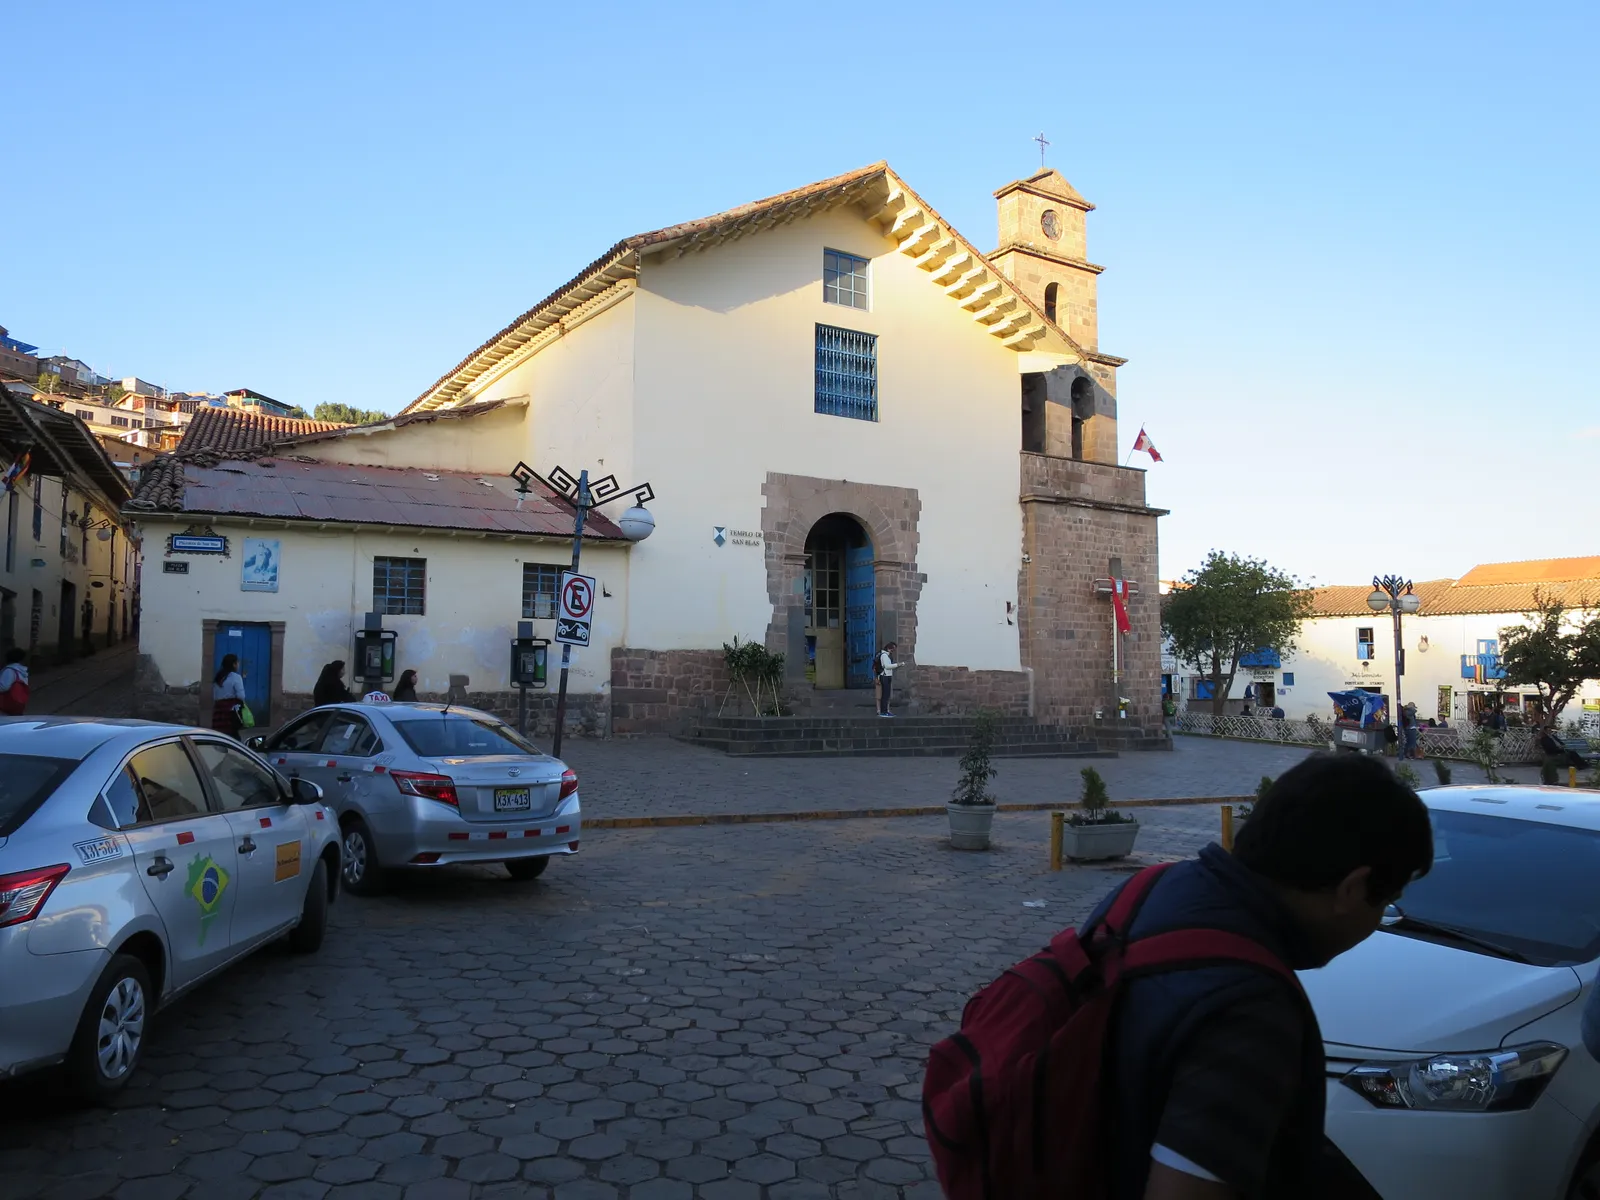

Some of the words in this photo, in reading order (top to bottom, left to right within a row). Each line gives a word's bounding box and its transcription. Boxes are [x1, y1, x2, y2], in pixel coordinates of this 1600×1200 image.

[730, 530, 754, 538] TEMPLO
[570, 585, 584, 610] E
[497, 794, 528, 806] X3X-413
